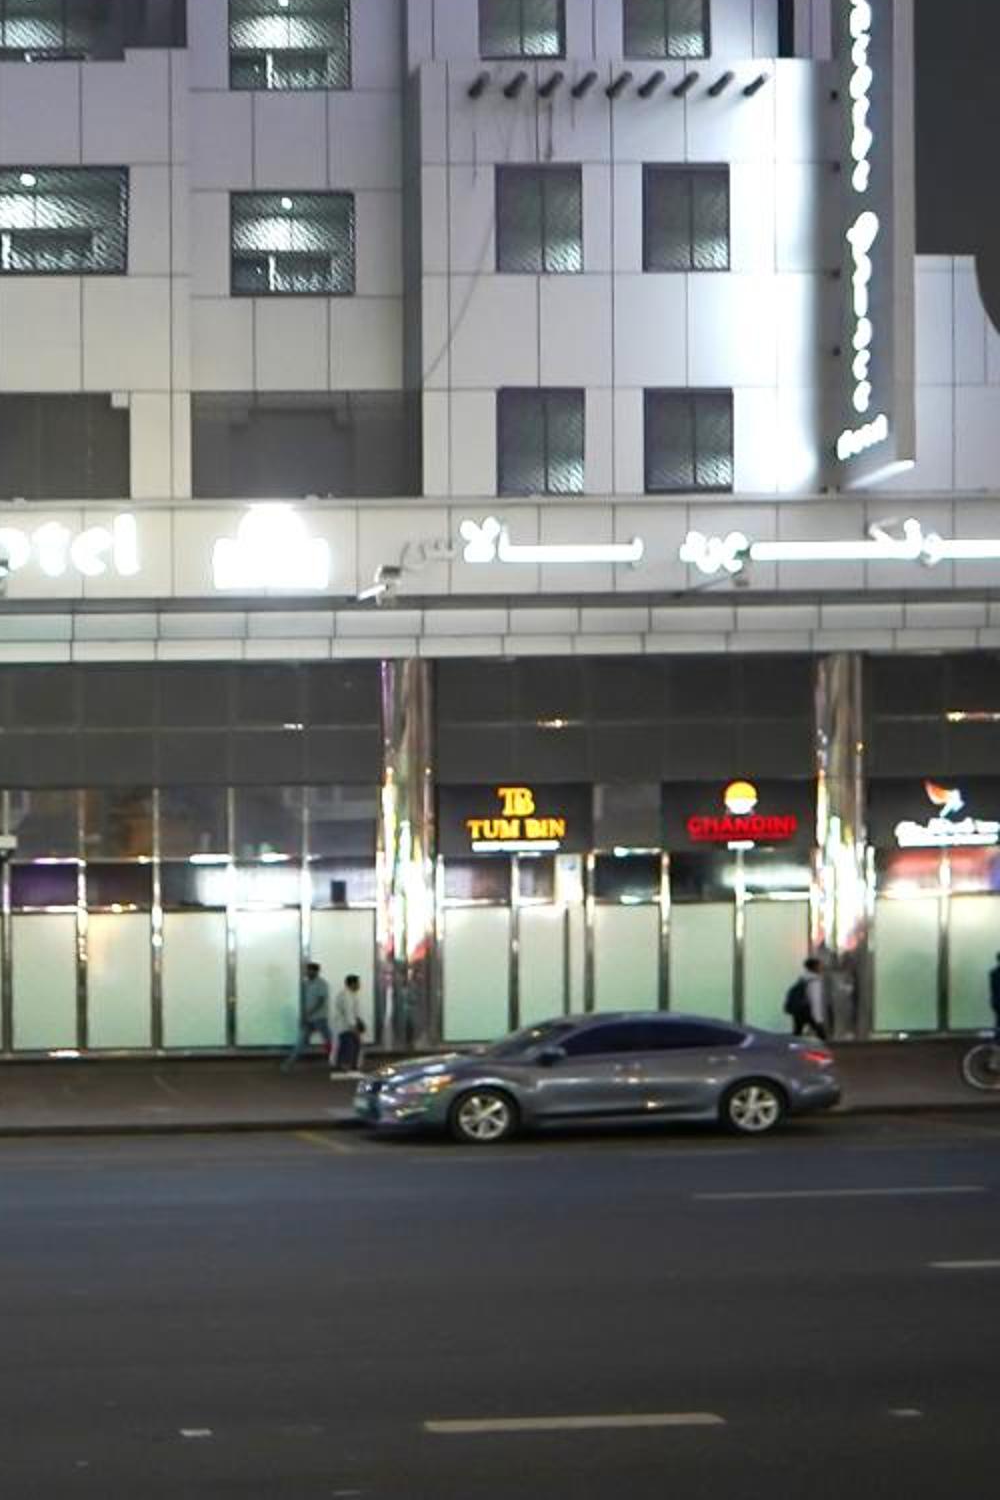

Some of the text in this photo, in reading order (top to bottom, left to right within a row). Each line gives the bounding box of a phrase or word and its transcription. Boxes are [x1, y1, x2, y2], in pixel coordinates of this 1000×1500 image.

[497, 786, 536, 817] TB
[466, 817, 566, 839] TUM BIN
[686, 812, 798, 836] CHANDINI
